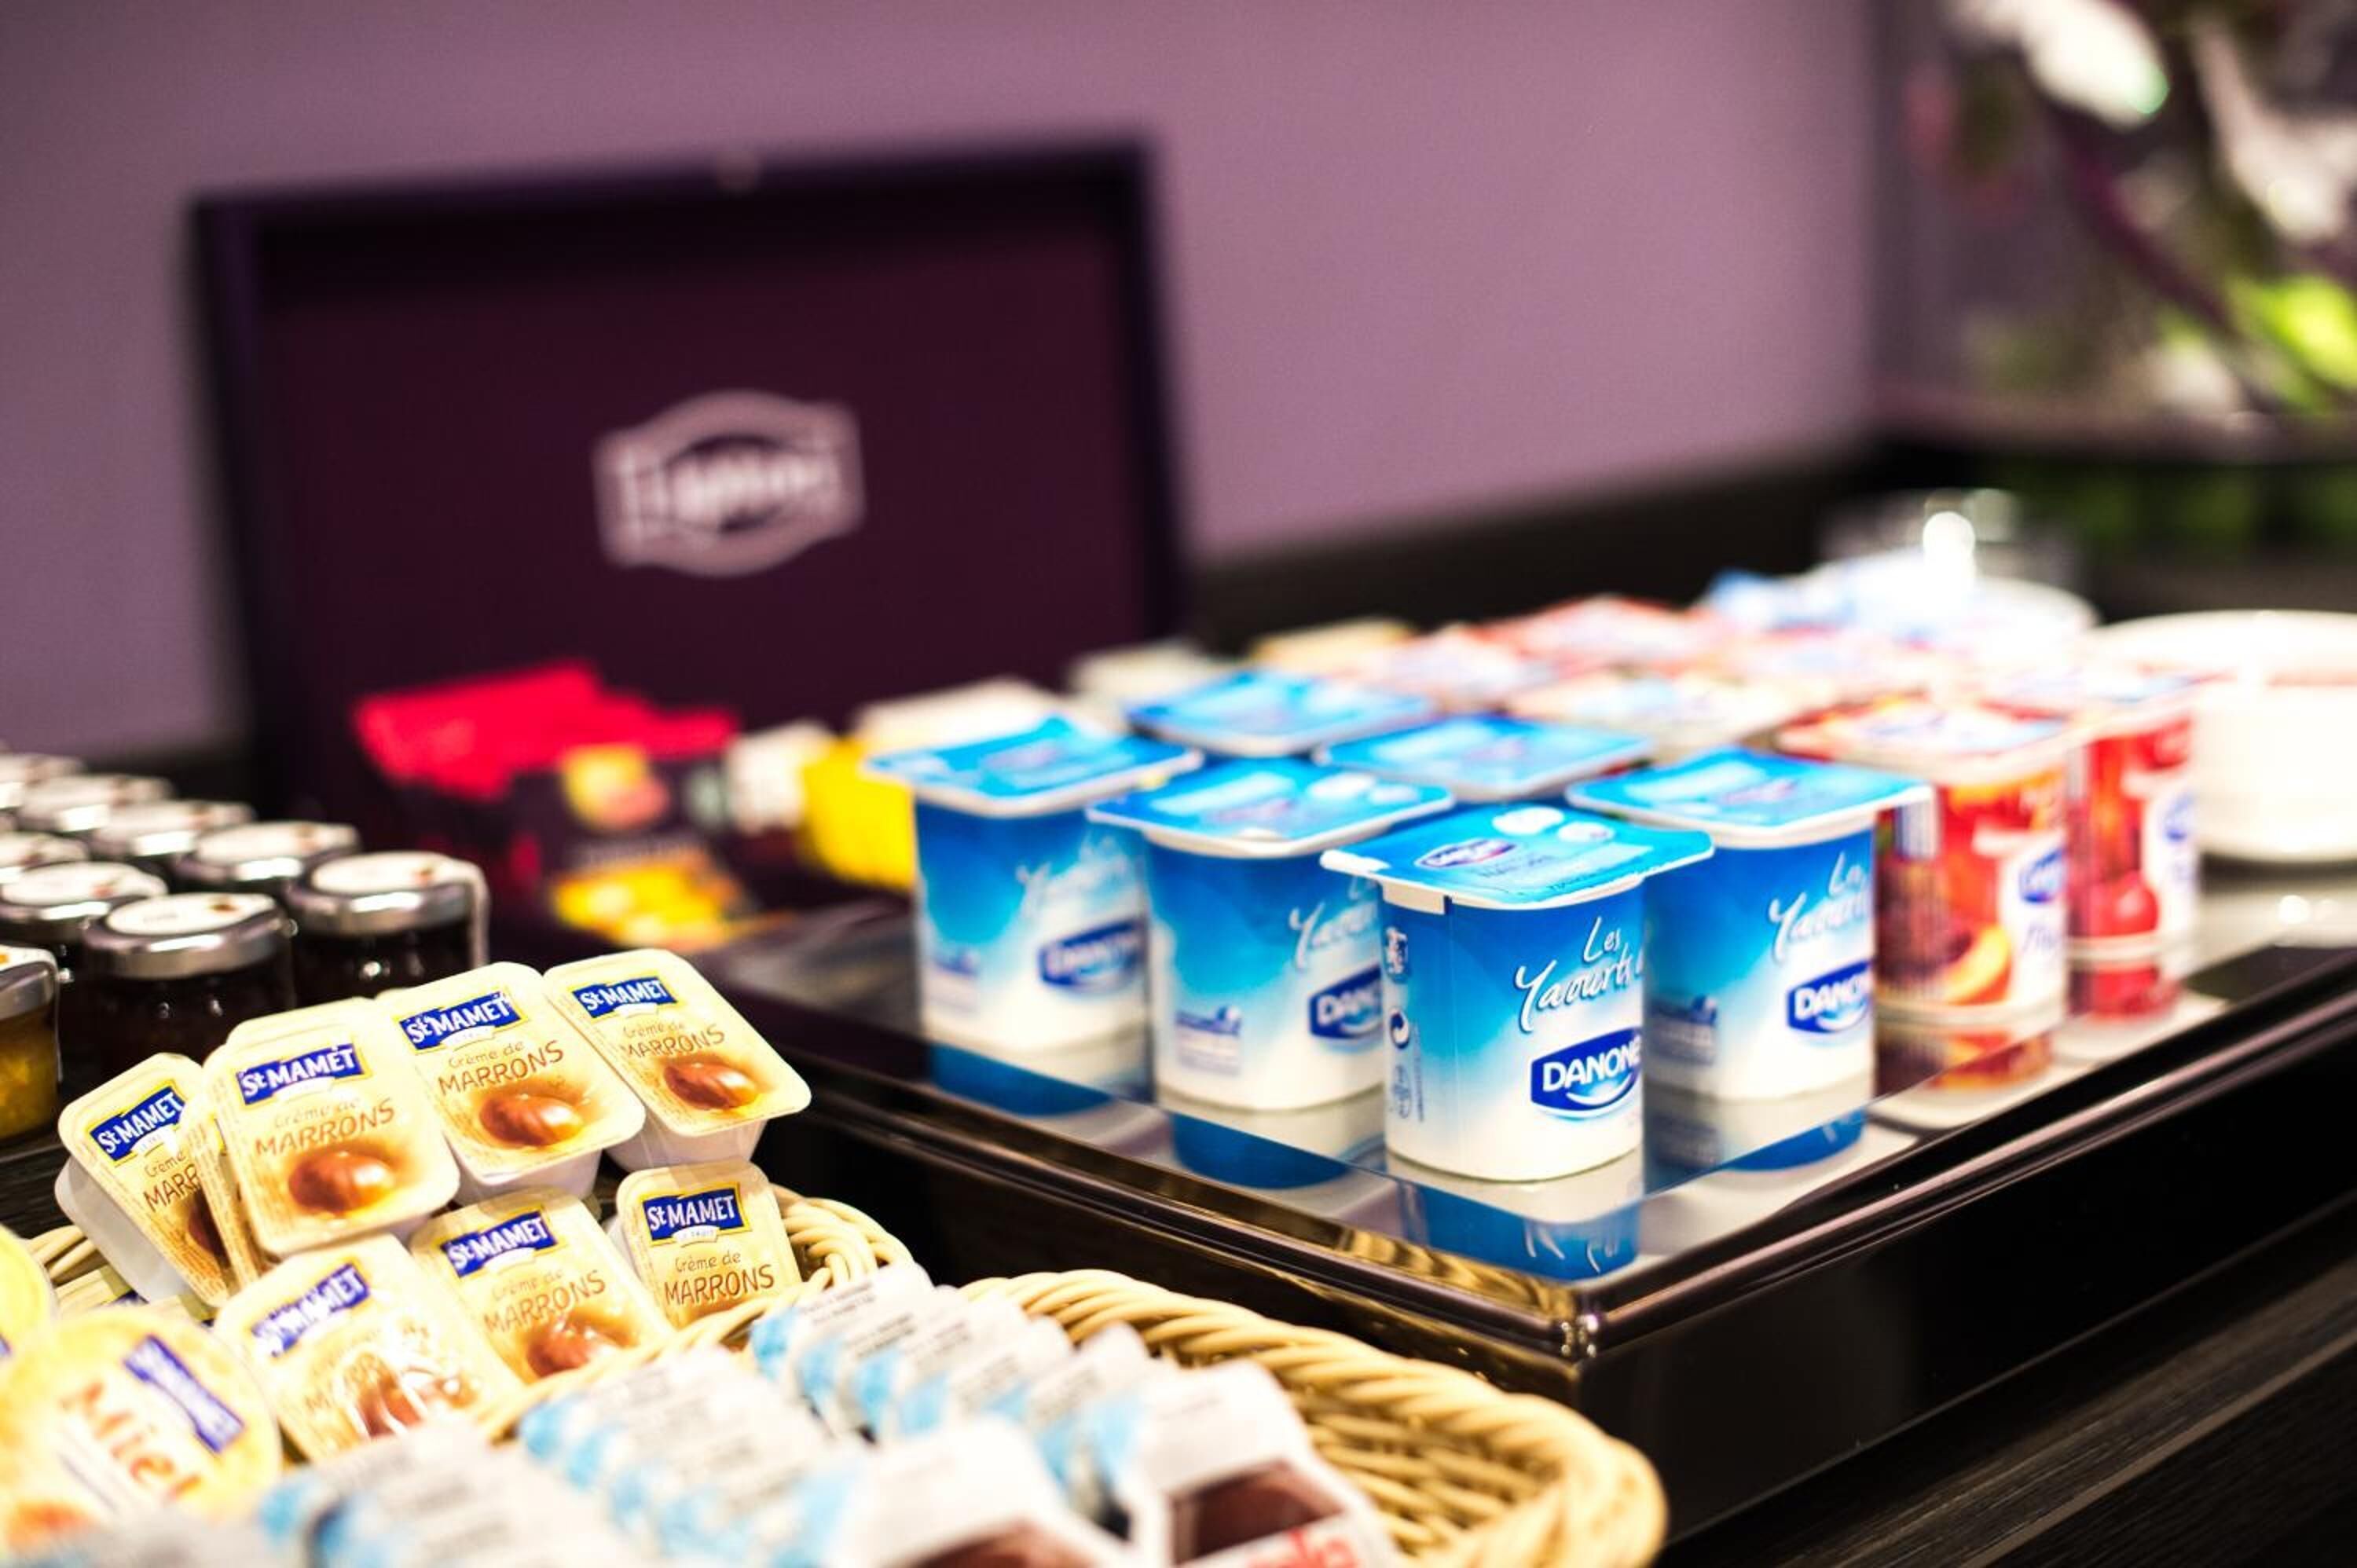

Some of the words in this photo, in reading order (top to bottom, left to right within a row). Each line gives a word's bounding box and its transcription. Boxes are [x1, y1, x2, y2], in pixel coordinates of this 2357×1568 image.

[1583, 916, 1621, 962] Les
[602, 979, 668, 1006] MAMET
[427, 997, 511, 1035] MAMET
[502, 1040, 526, 1057] de
[620, 1023, 726, 1058] MARRONS
[266, 1048, 356, 1089] MAMET
[437, 1039, 565, 1096] MARRONS
[115, 1091, 185, 1144] MAMET
[255, 1097, 396, 1157] MARRONS
[143, 1163, 200, 1214] MARR
[667, 1195, 736, 1228] MAMET
[471, 1218, 548, 1261] MAMET
[721, 1250, 742, 1265] de
[483, 1269, 607, 1333] MARRONS
[664, 1263, 775, 1306] MARRONS
